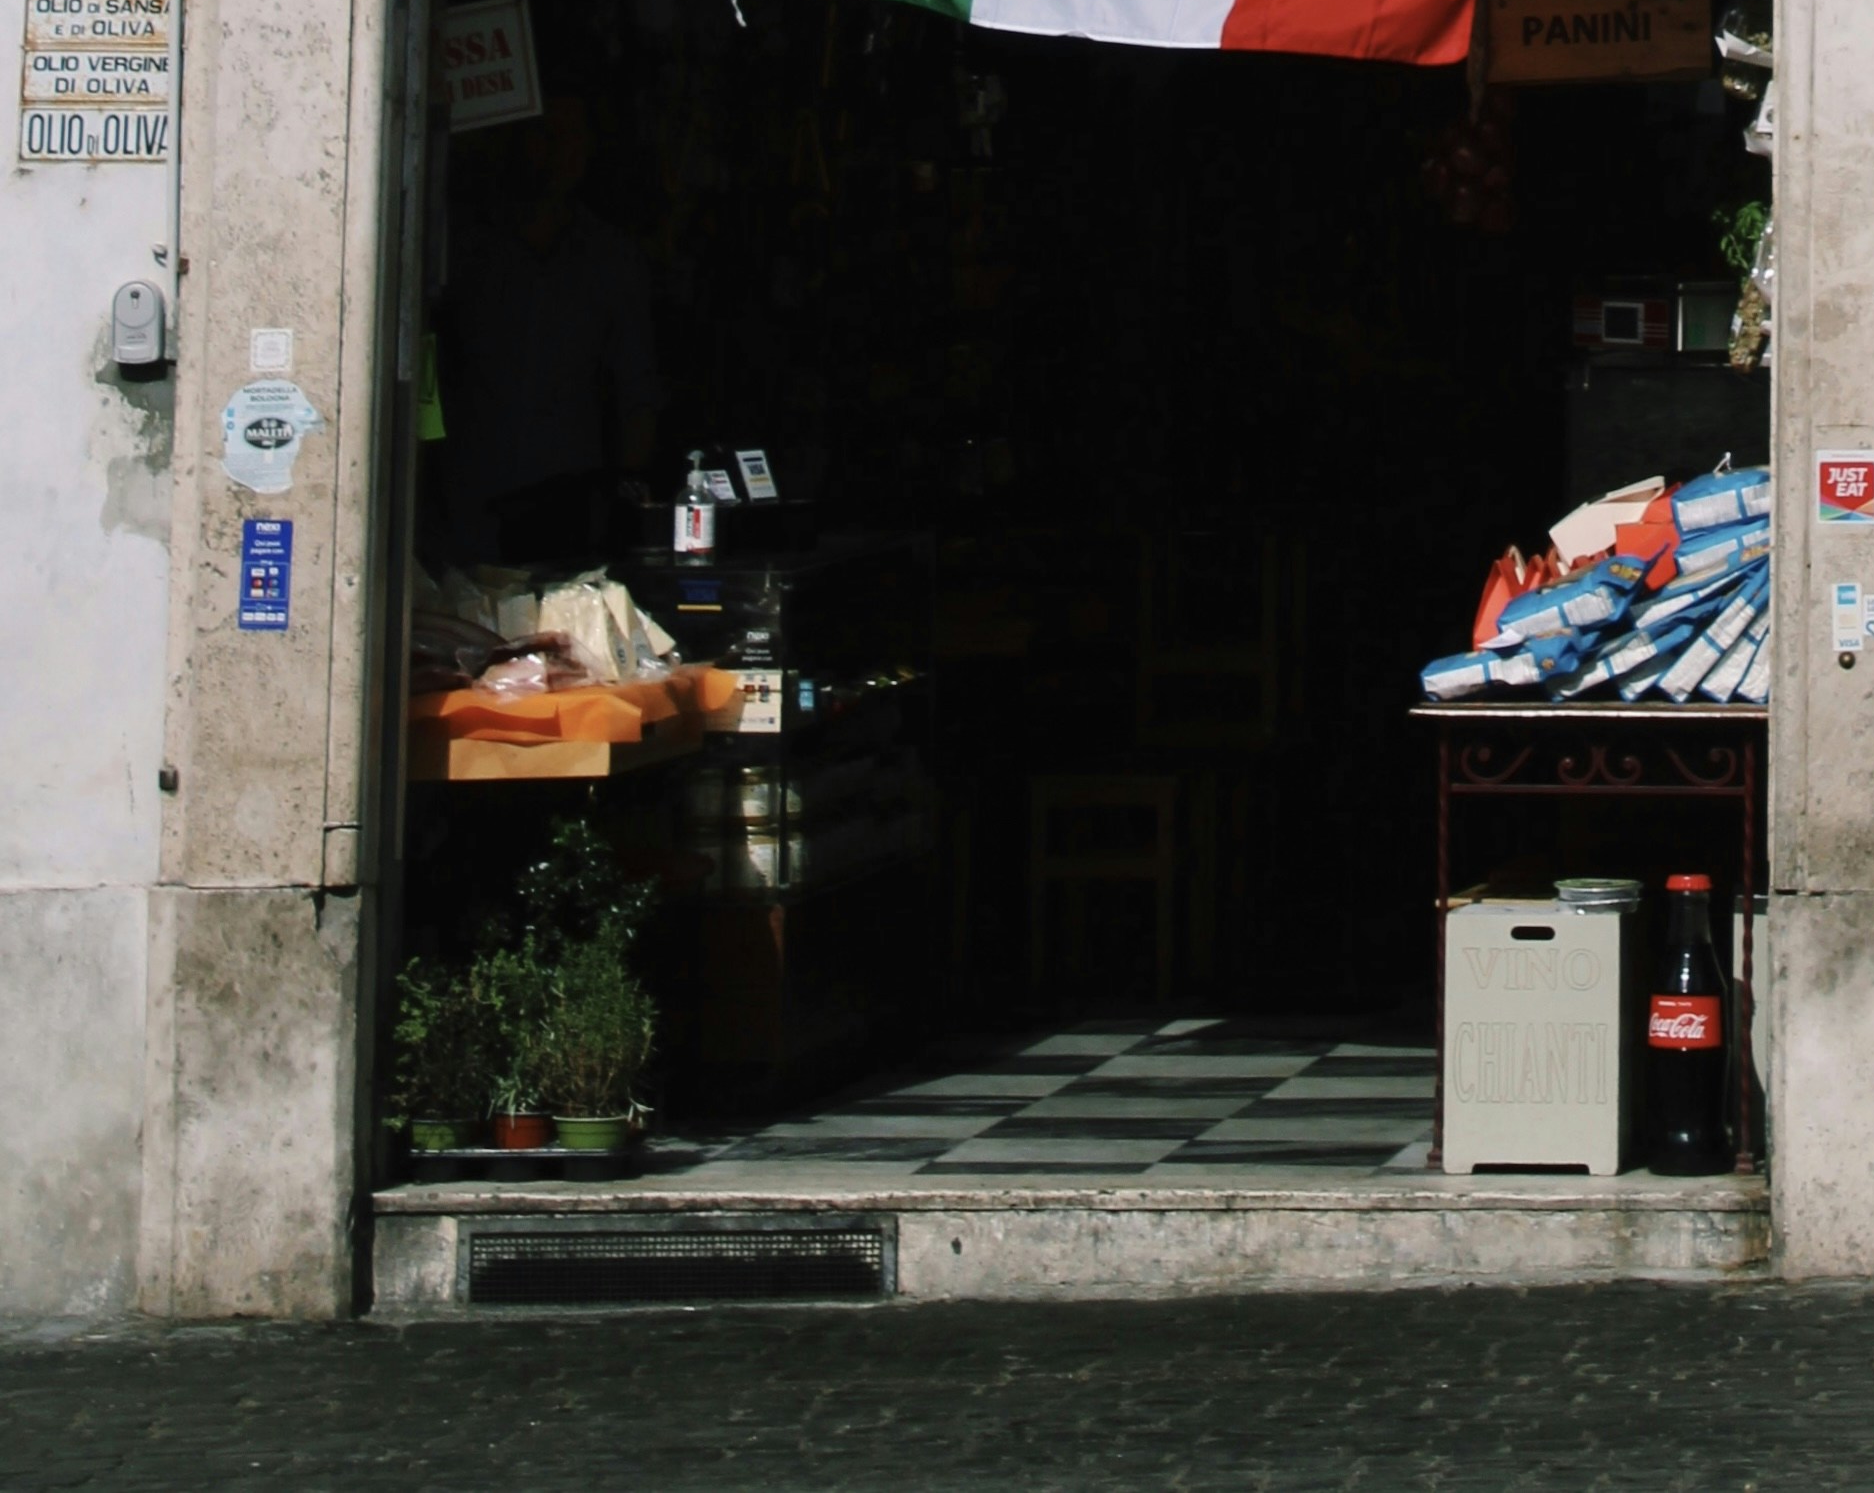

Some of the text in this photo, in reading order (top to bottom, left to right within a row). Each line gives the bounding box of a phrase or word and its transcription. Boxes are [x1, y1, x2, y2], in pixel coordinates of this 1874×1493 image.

[54, 20, 155, 36] E DI OLIVA
[1521, 8, 1653, 47] PANINI
[33, 55, 80, 72] OLIO
[54, 77, 150, 94] DI OLIVA
[461, 68, 515, 100] DESK
[28, 113, 84, 155] OLIO
[87, 133, 100, 156] DI
[1827, 467, 1869, 484] JUST
[1836, 482, 1869, 497] EAT
[1463, 946, 1603, 992] VINO
[1452, 1021, 1609, 1105] CHIANTI
